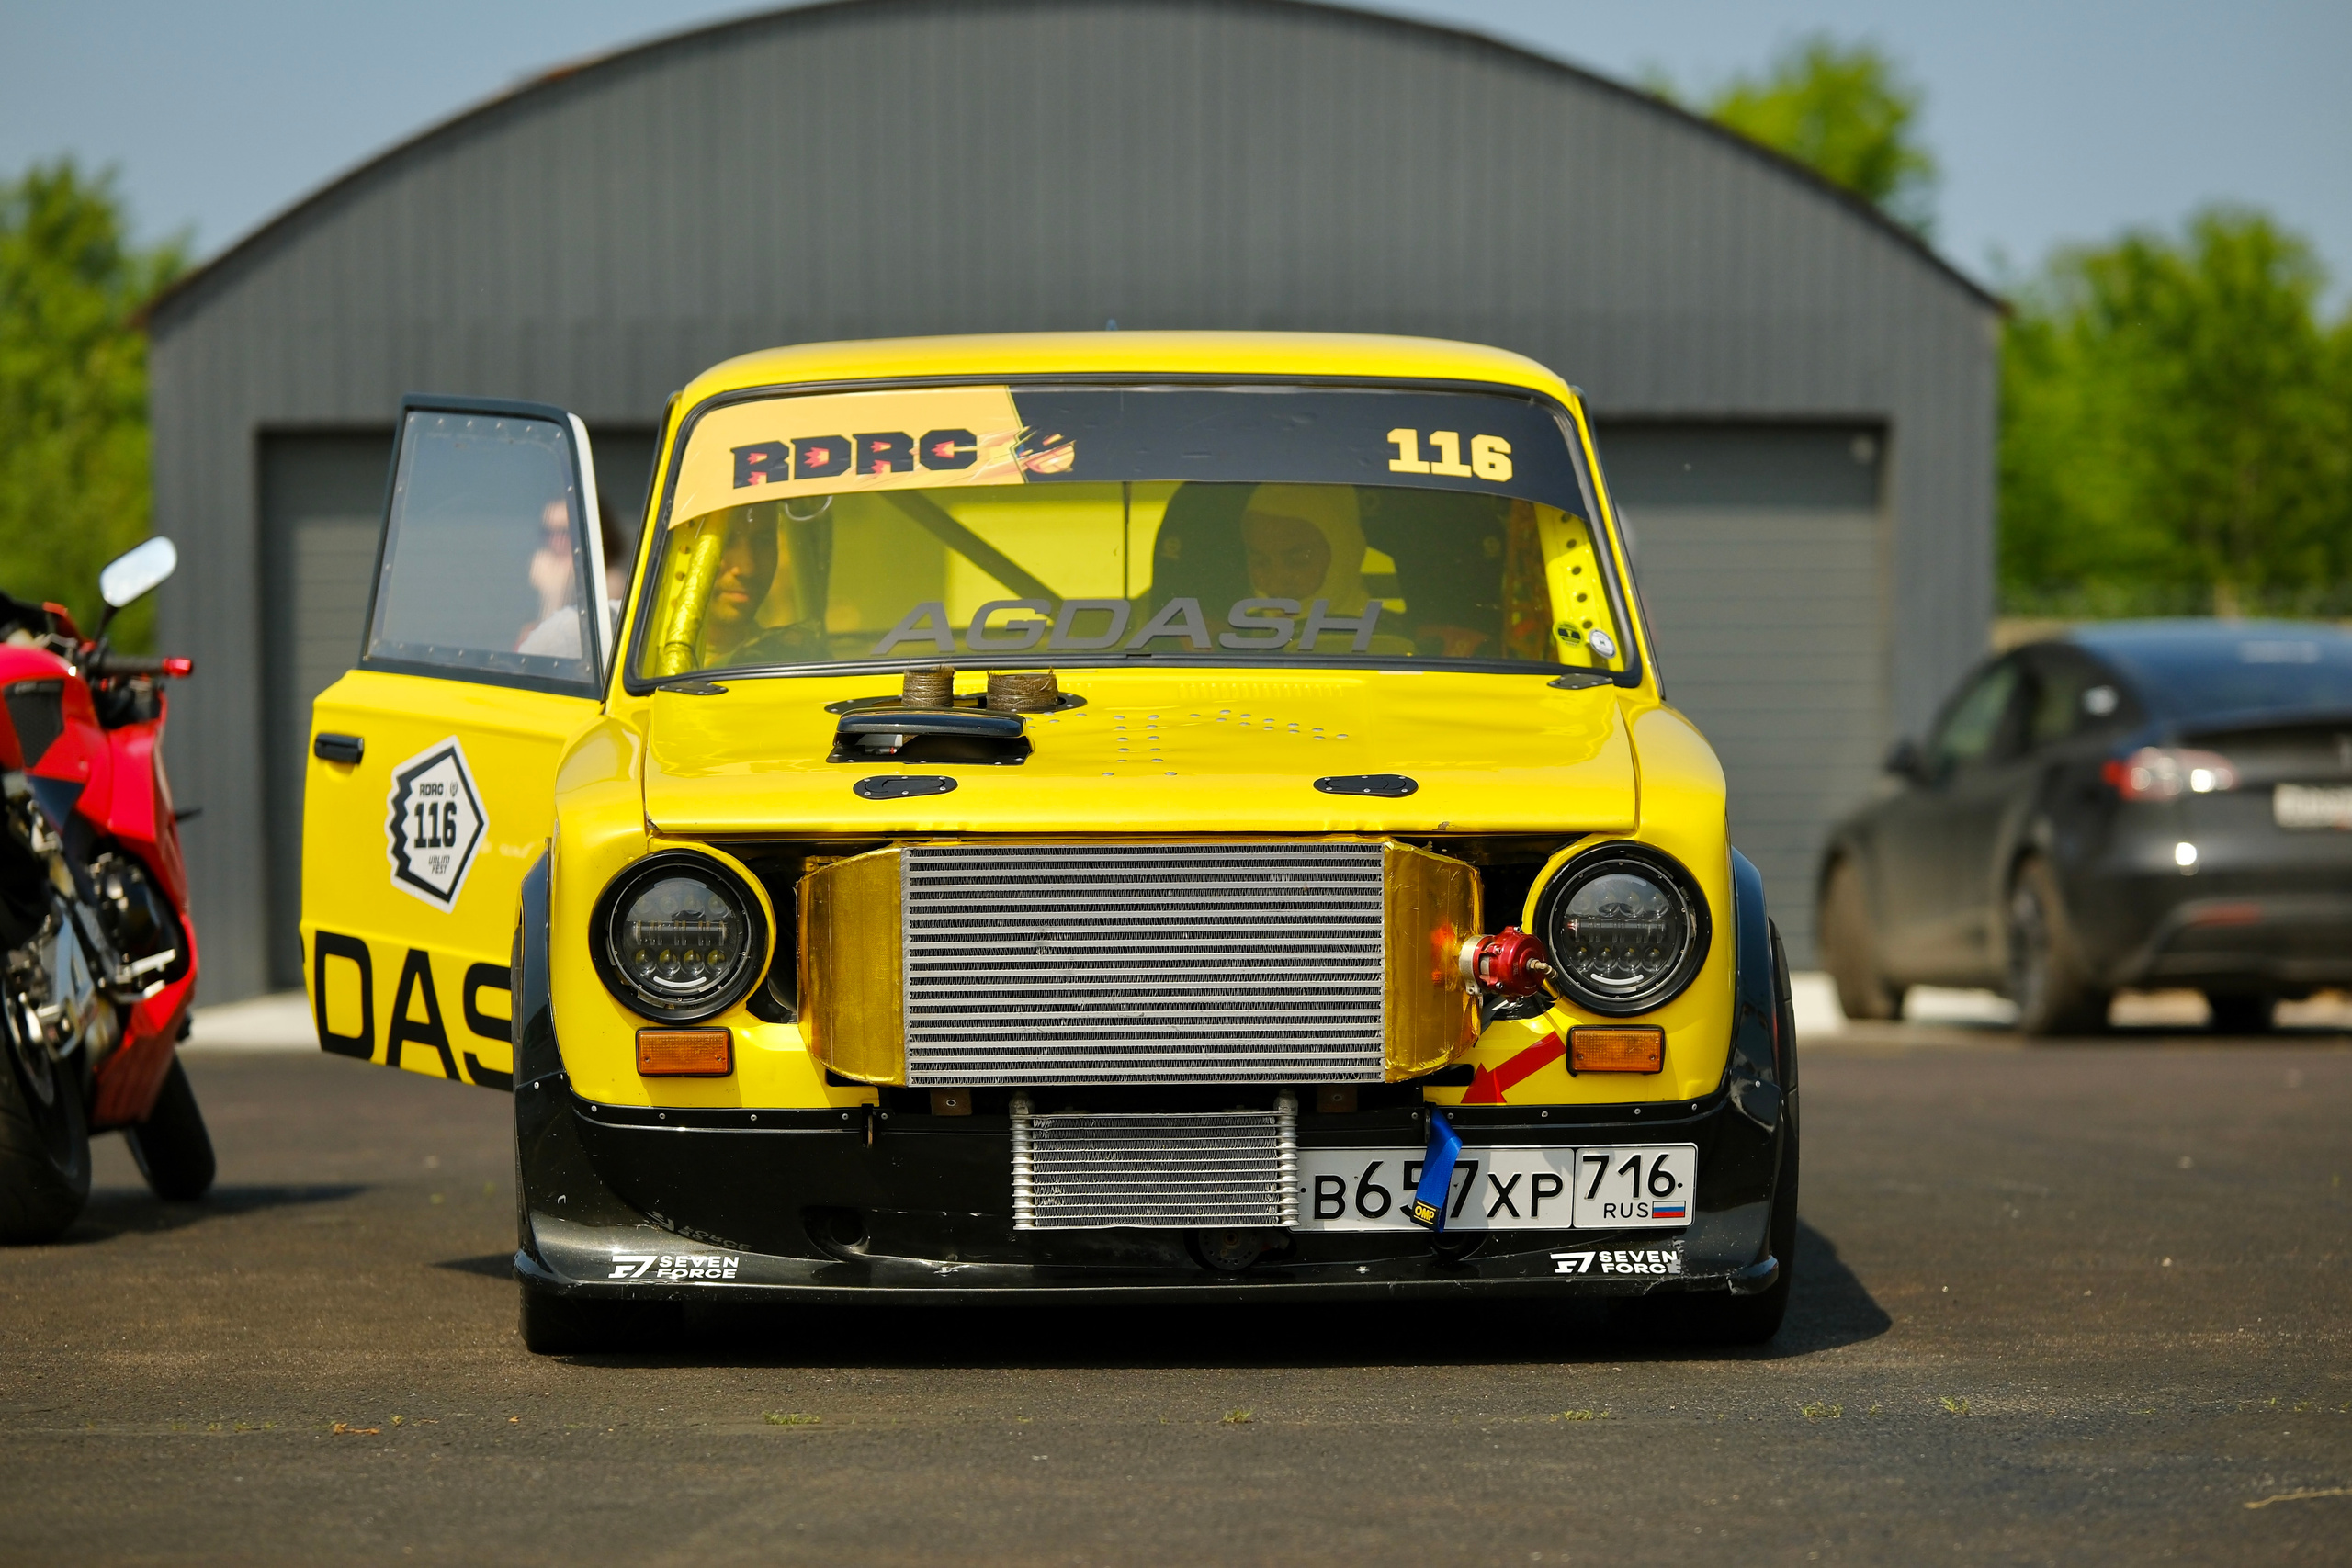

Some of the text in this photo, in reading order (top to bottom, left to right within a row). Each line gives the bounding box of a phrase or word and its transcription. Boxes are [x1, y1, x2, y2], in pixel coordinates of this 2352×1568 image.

[730, 429, 977, 489] RDRC
[1386, 427, 1513, 482] 116
[870, 597, 1382, 655] AGDASH
[419, 783, 444, 796] RDRC
[413, 801, 457, 849] 116
[431, 864, 447, 874] FEST
[314, 930, 513, 1092] DAS
[1582, 1154, 1676, 1200] 716
[1414, 1204, 1435, 1222] OMP
[1603, 1202, 1649, 1219] RUS
[659, 1256, 740, 1268] SEVEN
[1599, 1250, 1679, 1263] SEVEN
[656, 1269, 737, 1279] FORCE
[1601, 1262, 1681, 1274] FORCE
